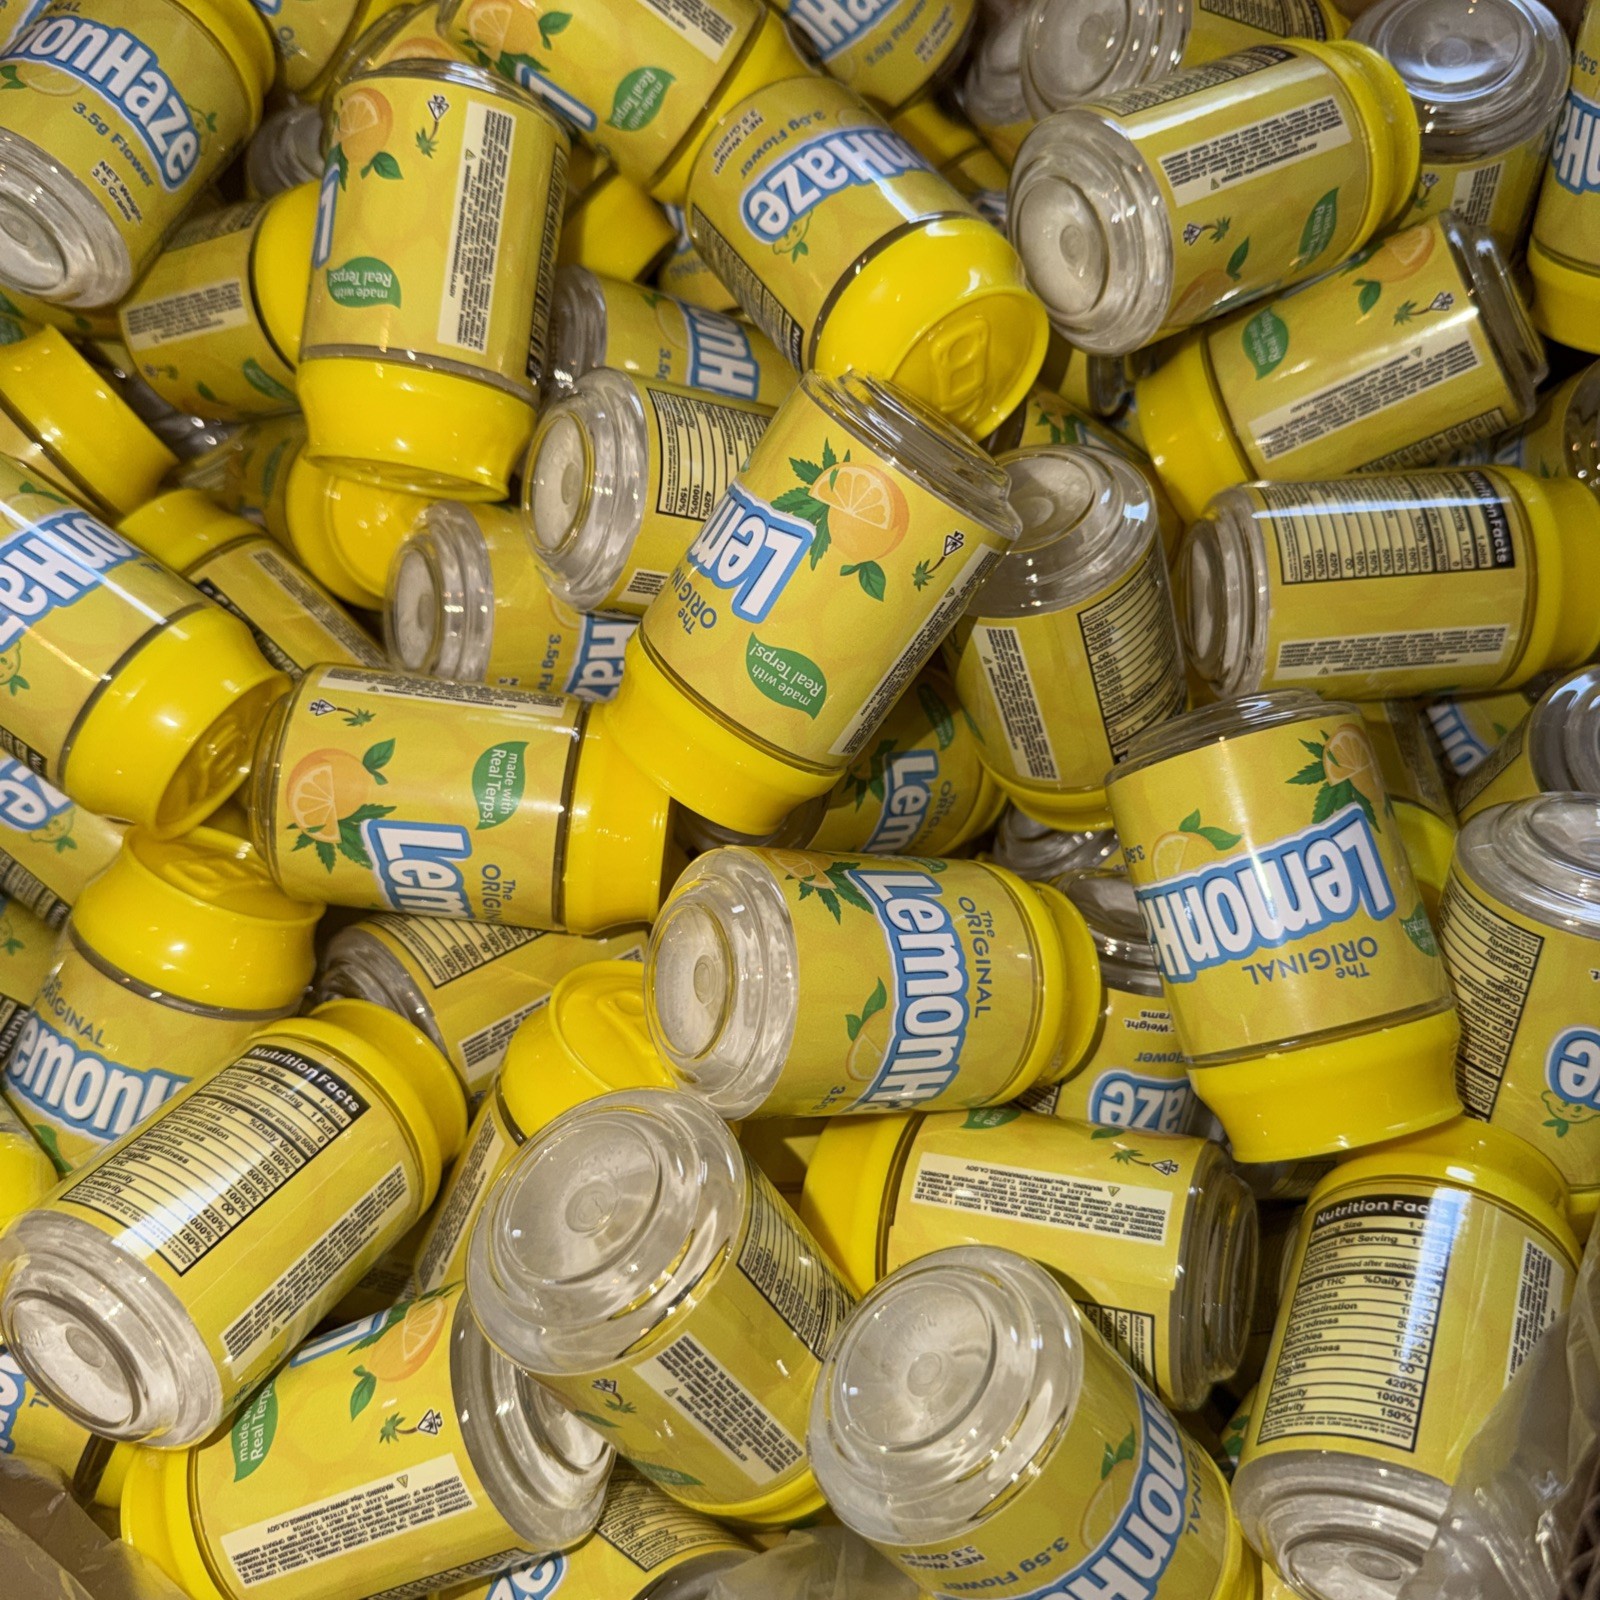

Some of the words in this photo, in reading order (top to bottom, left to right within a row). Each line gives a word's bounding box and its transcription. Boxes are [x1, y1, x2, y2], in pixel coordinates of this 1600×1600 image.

[6, 18, 199, 182] onHaze
[73, 102, 109, 136] 3.5g
[110, 132, 154, 188] Flower
[740, 129, 788, 178] Flower
[748, 131, 930, 236] nHaze
[361, 272, 392, 288] Real
[678, 487, 688, 513] 150%
[690, 484, 701, 516] 1000%
[1489, 519, 1507, 563] Facts
[671, 566, 717, 629] ORIGIN
[678, 607, 696, 635] The
[541, 633, 562, 670] 3.5g
[748, 642, 793, 681] Terps!
[751, 664, 777, 687] with
[792, 671, 823, 698] Real
[778, 682, 812, 707] made
[488, 749, 507, 778] Real
[506, 752, 518, 785] made
[480, 780, 501, 824] Terps!
[500, 788, 513, 815] with
[481, 864, 503, 921] ORIGIN
[502, 879, 516, 901] The
[1140, 820, 1392, 977] LemonH
[981, 910, 996, 939] The
[958, 896, 993, 1018] ORIGINAL
[1242, 936, 1379, 986] ORIGINAL
[1484, 949, 1528, 978] Ingenuity
[1487, 935, 1532, 965] Creativity
[1335, 963, 1370, 979] The
[1502, 974, 1525, 991] THC
[861, 872, 966, 1110] LemonH
[1459, 973, 1518, 1016] Forgetfulness
[1485, 979, 1521, 1002] Giggles
[1140, 1010, 1171, 1019] rams
[1470, 997, 1514, 1028] Munchies
[1134, 1051, 1185, 1063] lower
[250, 1047, 319, 1079] Nutrition
[317, 1073, 361, 1113] Facts
[268, 1065, 287, 1079] Size
[254, 1076, 270, 1087] Per
[270, 1084, 304, 1108] Serving
[217, 1100, 239, 1115] THC
[325, 1103, 347, 1124] Joint
[259, 1105, 276, 1119] after
[275, 1114, 303, 1141] smoking
[300, 1138, 317, 1154] 5000
[316, 1116, 335, 1136] Puff
[168, 1113, 230, 1141] Procrastination
[258, 1160, 281, 1184] 100%
[249, 1117, 279, 1143] %Daily
[278, 1139, 301, 1165] Value
[145, 1131, 184, 1147] Munchies
[237, 1179, 258, 1203] 150%
[173, 1124, 206, 1143] redness
[246, 1169, 270, 1193] 500%
[269, 1150, 292, 1175] 100%
[96, 1168, 137, 1184] Ingenuity
[133, 1140, 190, 1164] Forgetfulness
[224, 1188, 248, 1212] 100%
[109, 1158, 129, 1167] THC
[201, 1208, 225, 1233] 420%
[84, 1177, 125, 1195] Creativity
[178, 1228, 202, 1254] 150%
[1316, 1200, 1389, 1226] Nutrition
[1342, 1220, 1363, 1229] Size
[1338, 1235, 1355, 1244] Per
[1357, 1233, 1399, 1245] Serving
[1326, 1276, 1346, 1285] THC
[1363, 1275, 1401, 1288] %Daily
[1376, 1391, 1415, 1408] 1000%
[1384, 1377, 1419, 1393] 420%
[1379, 1407, 1413, 1423] 150%
[238, 1422, 250, 1462] made
[250, 1423, 265, 1461] Real
[619, 1531, 640, 1546] THC
[952, 1554, 986, 1568] NET
[1019, 1537, 1070, 1573] 3.5g
[942, 1570, 1019, 1591] Flower
